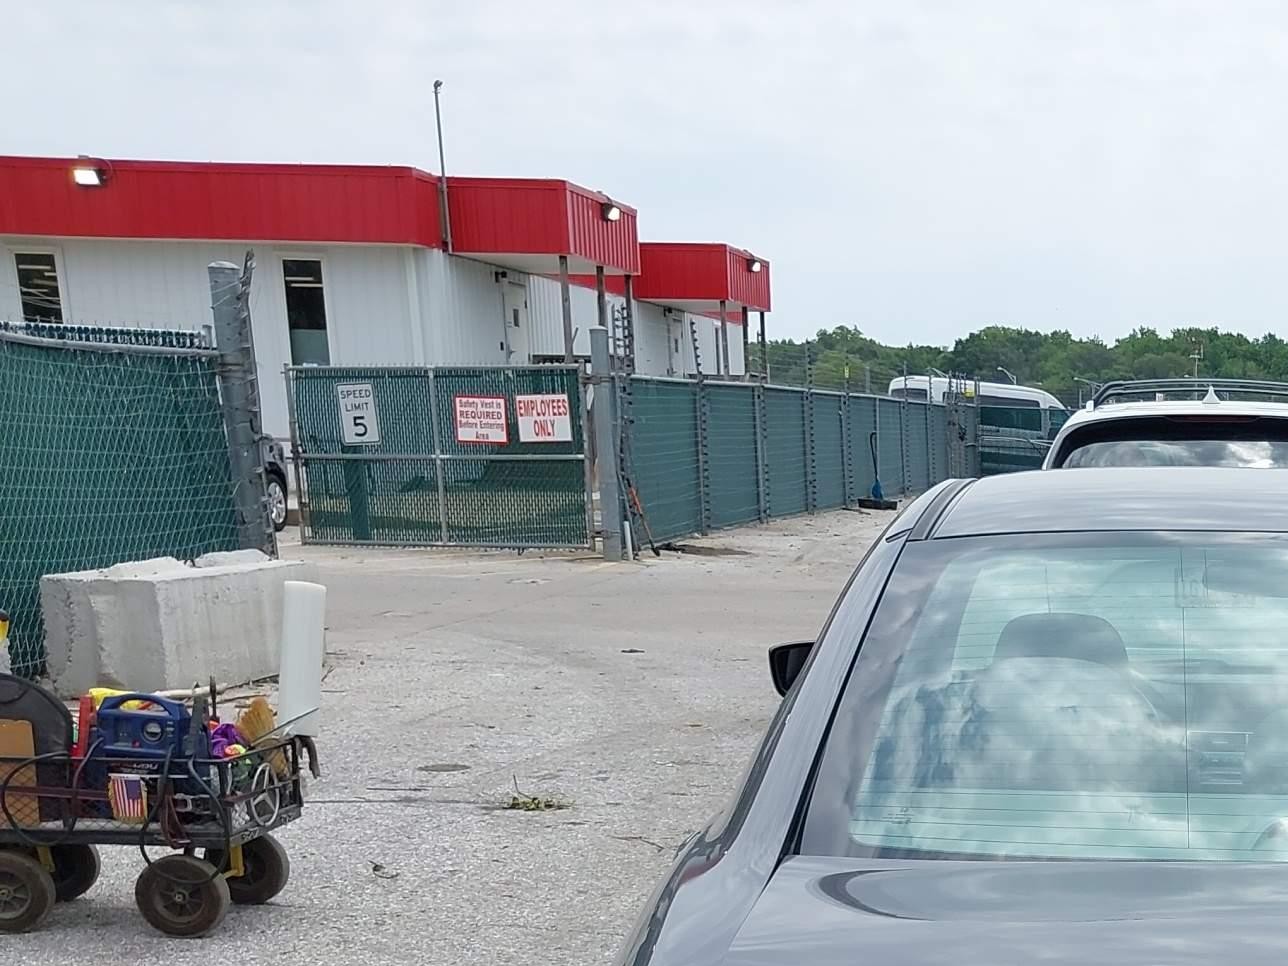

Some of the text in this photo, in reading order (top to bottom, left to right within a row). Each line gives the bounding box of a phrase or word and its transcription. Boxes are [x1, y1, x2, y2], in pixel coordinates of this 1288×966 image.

[340, 389, 371, 399] SPEED
[345, 402, 369, 412] LIMIT
[459, 399, 478, 410] Safety
[480, 401, 494, 409] Vest
[518, 399, 568, 417] EMPLOYEES
[459, 410, 503, 420] REQUIRED
[353, 416, 368, 437] 5
[459, 420, 504, 432] Before Entering
[533, 419, 556, 437] ONLY
[476, 431, 490, 440] Area
